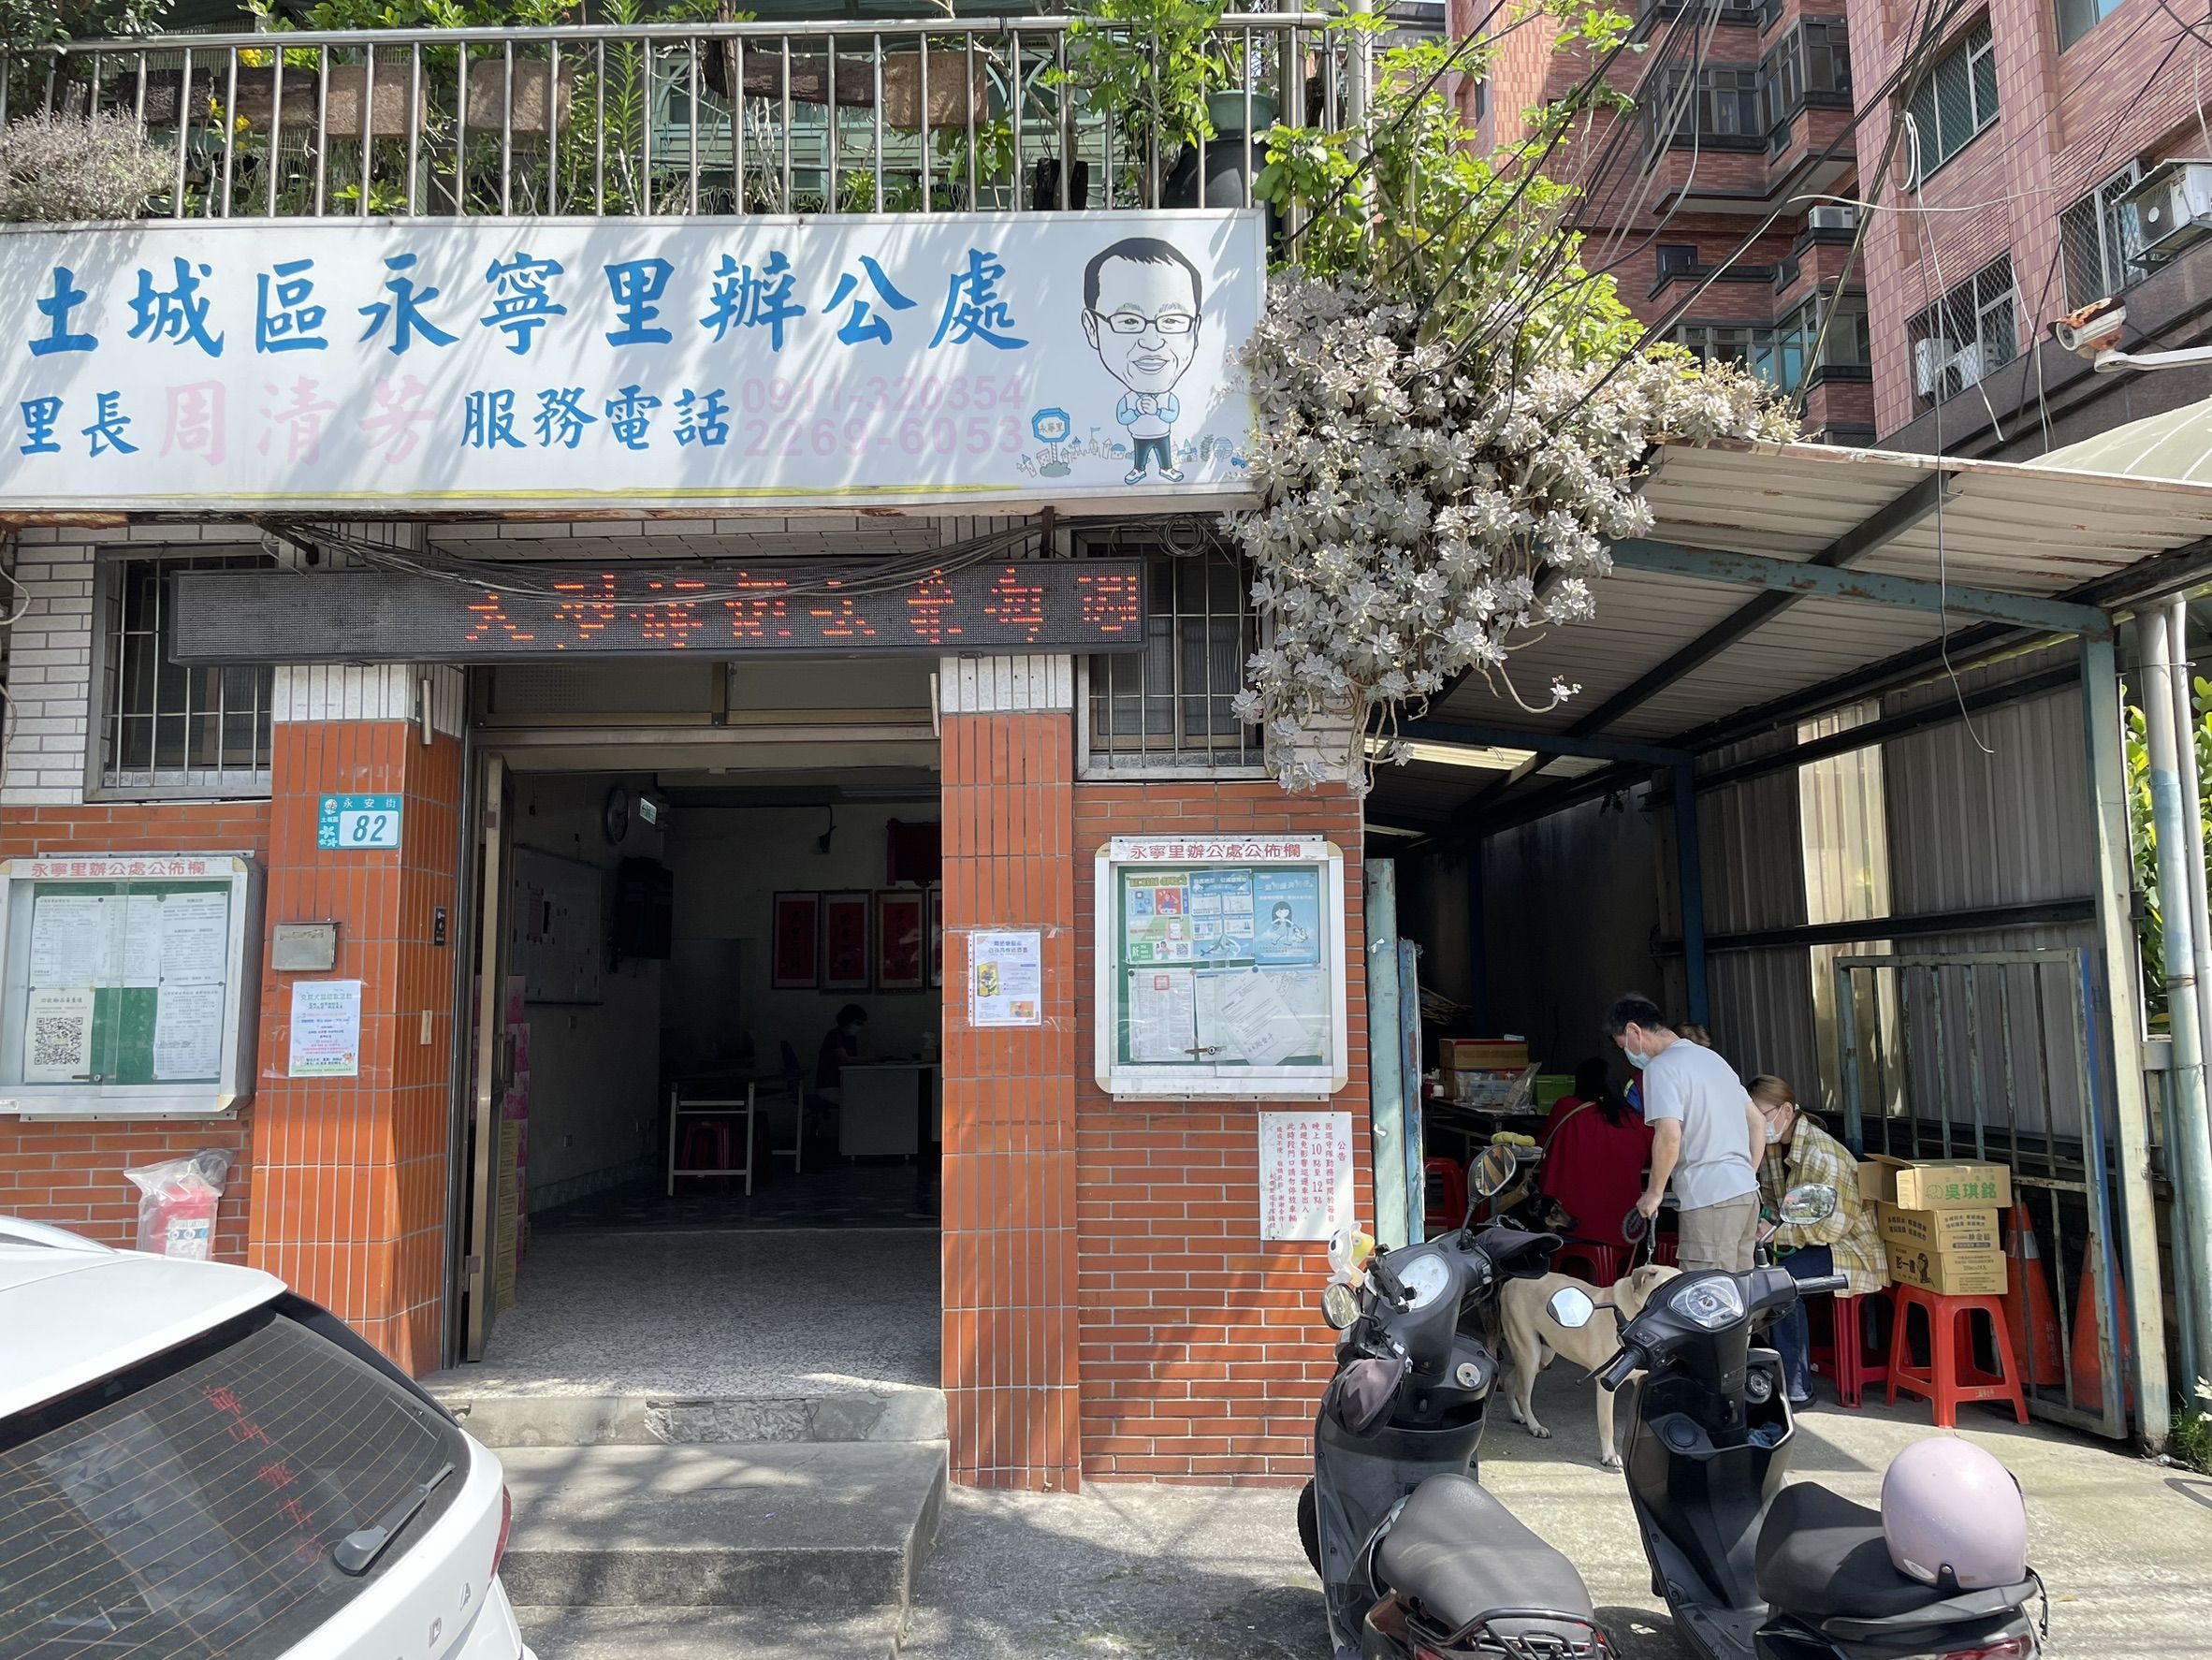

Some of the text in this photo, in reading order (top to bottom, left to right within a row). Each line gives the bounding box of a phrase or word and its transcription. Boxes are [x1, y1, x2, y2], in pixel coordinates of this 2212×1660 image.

[28, 249, 1029, 357] 土城區永寧里辦公處
[741, 375, 1025, 413] 0911-320354
[19, 374, 731, 466] 里長 周清芳 服務電話
[743, 415, 1025, 458] 2269-6053
[342, 797, 397, 808] 永安街
[352, 814, 387, 842] 82
[1129, 843, 1302, 860] 永寧里辦公處公佈欄
[31, 861, 206, 878] 永寧里辦公處公佈欄
[1337, 1141, 1346, 1162] 公告
[1945, 1182, 1997, 1200] 吳琪銘
